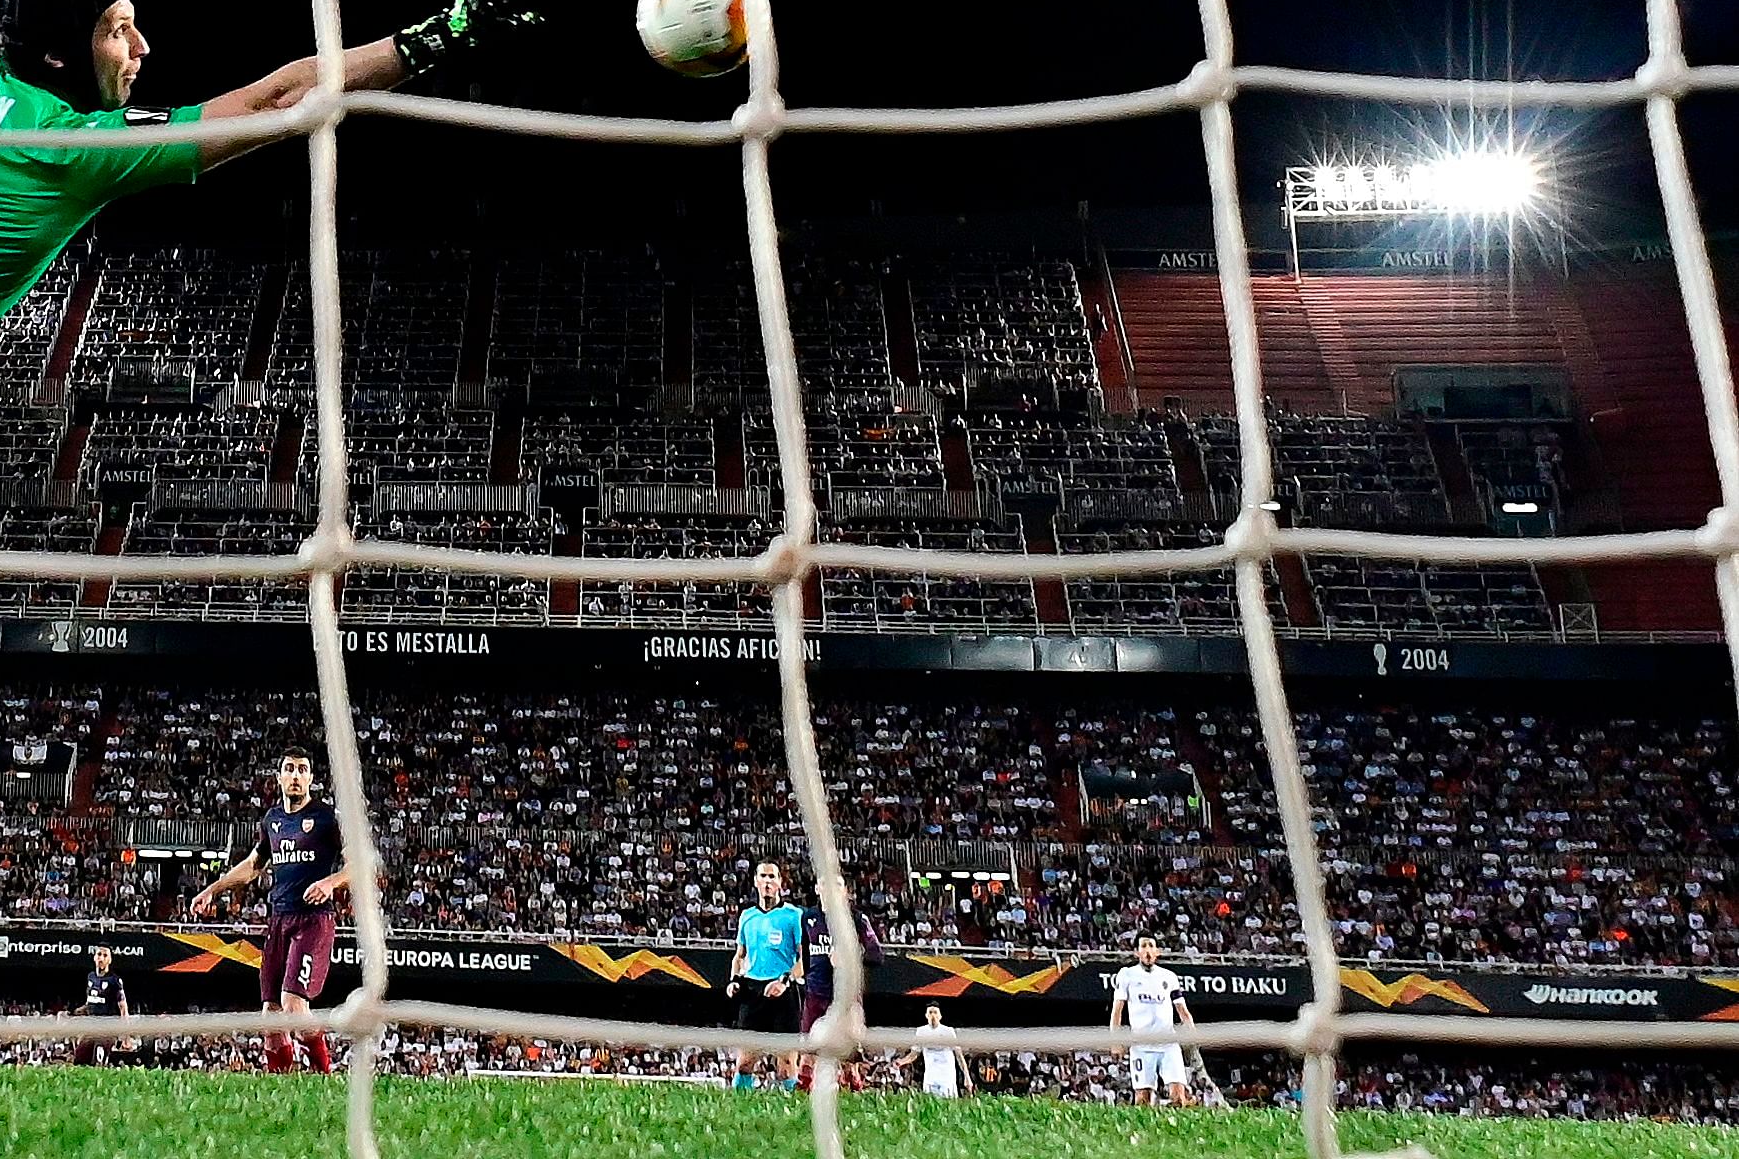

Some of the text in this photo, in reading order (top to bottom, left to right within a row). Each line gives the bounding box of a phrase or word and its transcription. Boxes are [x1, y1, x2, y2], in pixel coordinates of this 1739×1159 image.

[83, 626, 129, 648] 2004
[366, 631, 388, 652] ES
[396, 632, 490, 655] MESTALLA
[644, 636, 731, 662] ¡GRACIAS
[1400, 648, 1450, 671] 2004
[301, 954, 312, 979] 5
[330, 947, 532, 971] UEF EUROPA LEAGUE
[1200, 976, 1227, 994] TO
[1231, 976, 1287, 996] BAKU
